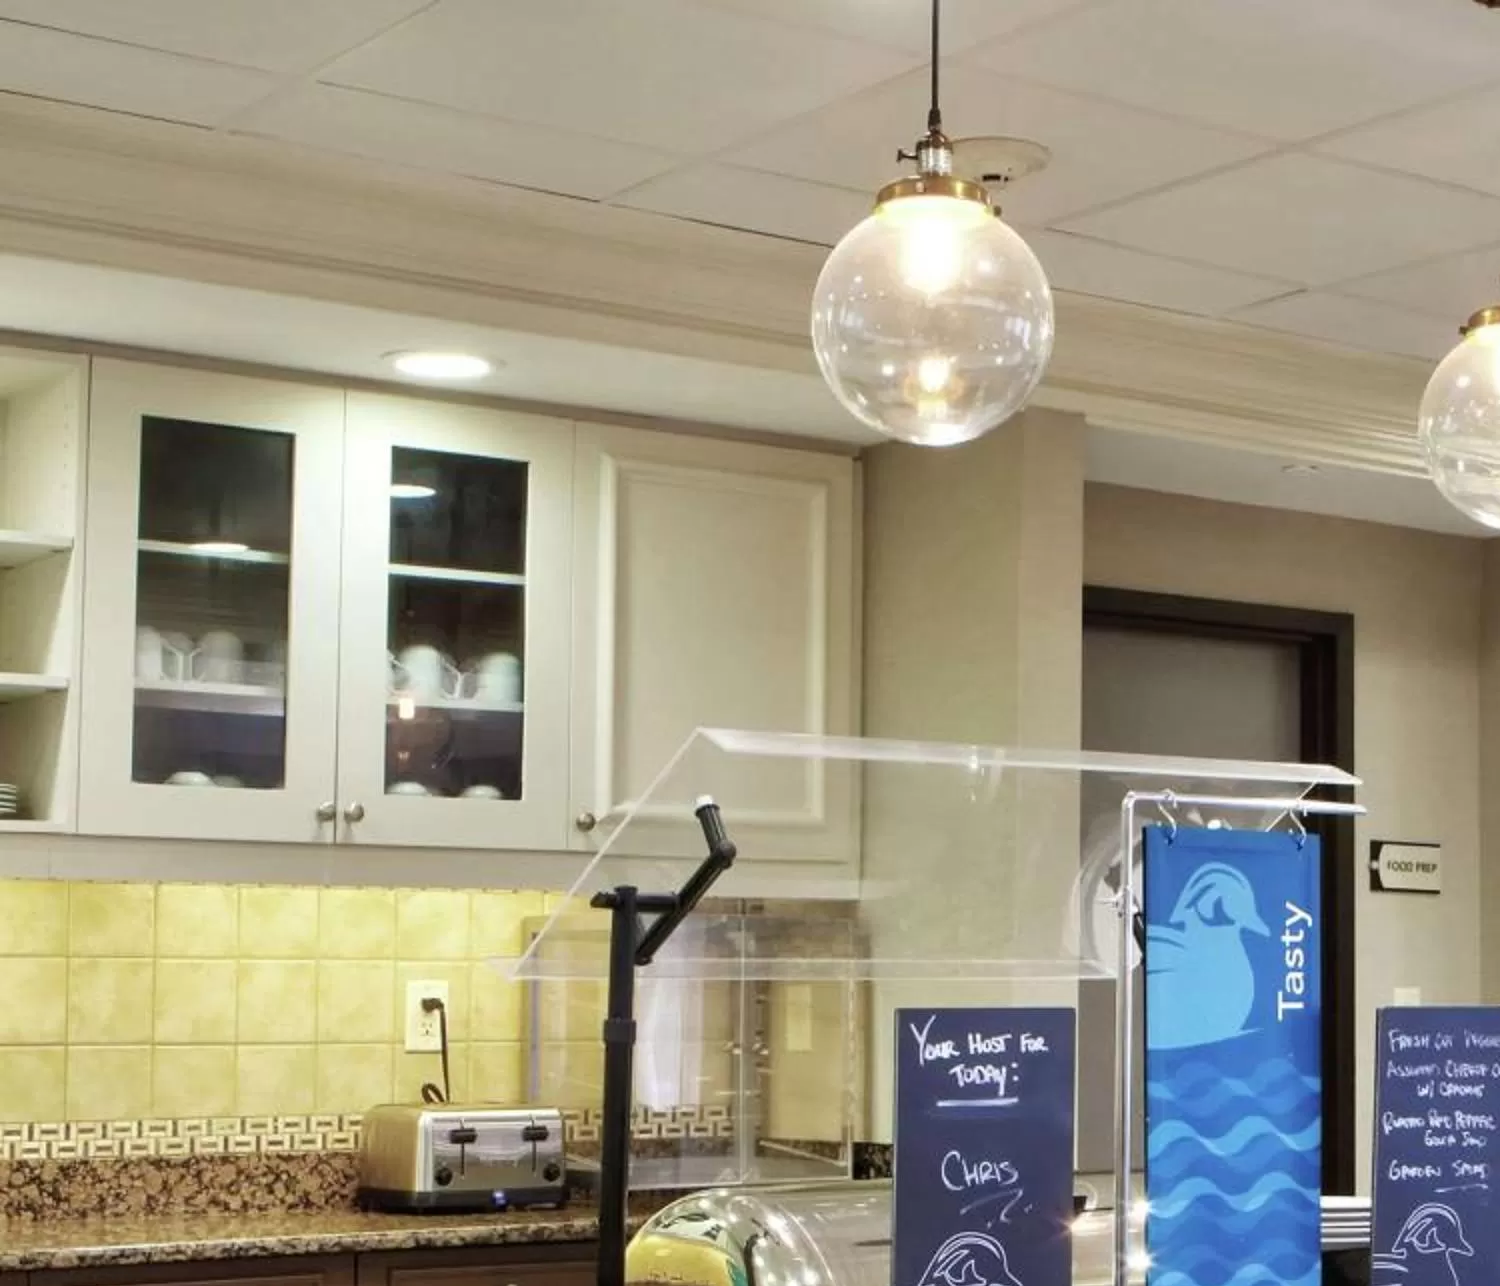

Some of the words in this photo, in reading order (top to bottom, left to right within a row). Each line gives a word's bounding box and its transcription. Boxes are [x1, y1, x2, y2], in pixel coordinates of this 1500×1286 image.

[1277, 901, 1312, 1022] Tasty
[968, 1032, 1013, 1055] HOST
[941, 1150, 1019, 1191] CHRIS
